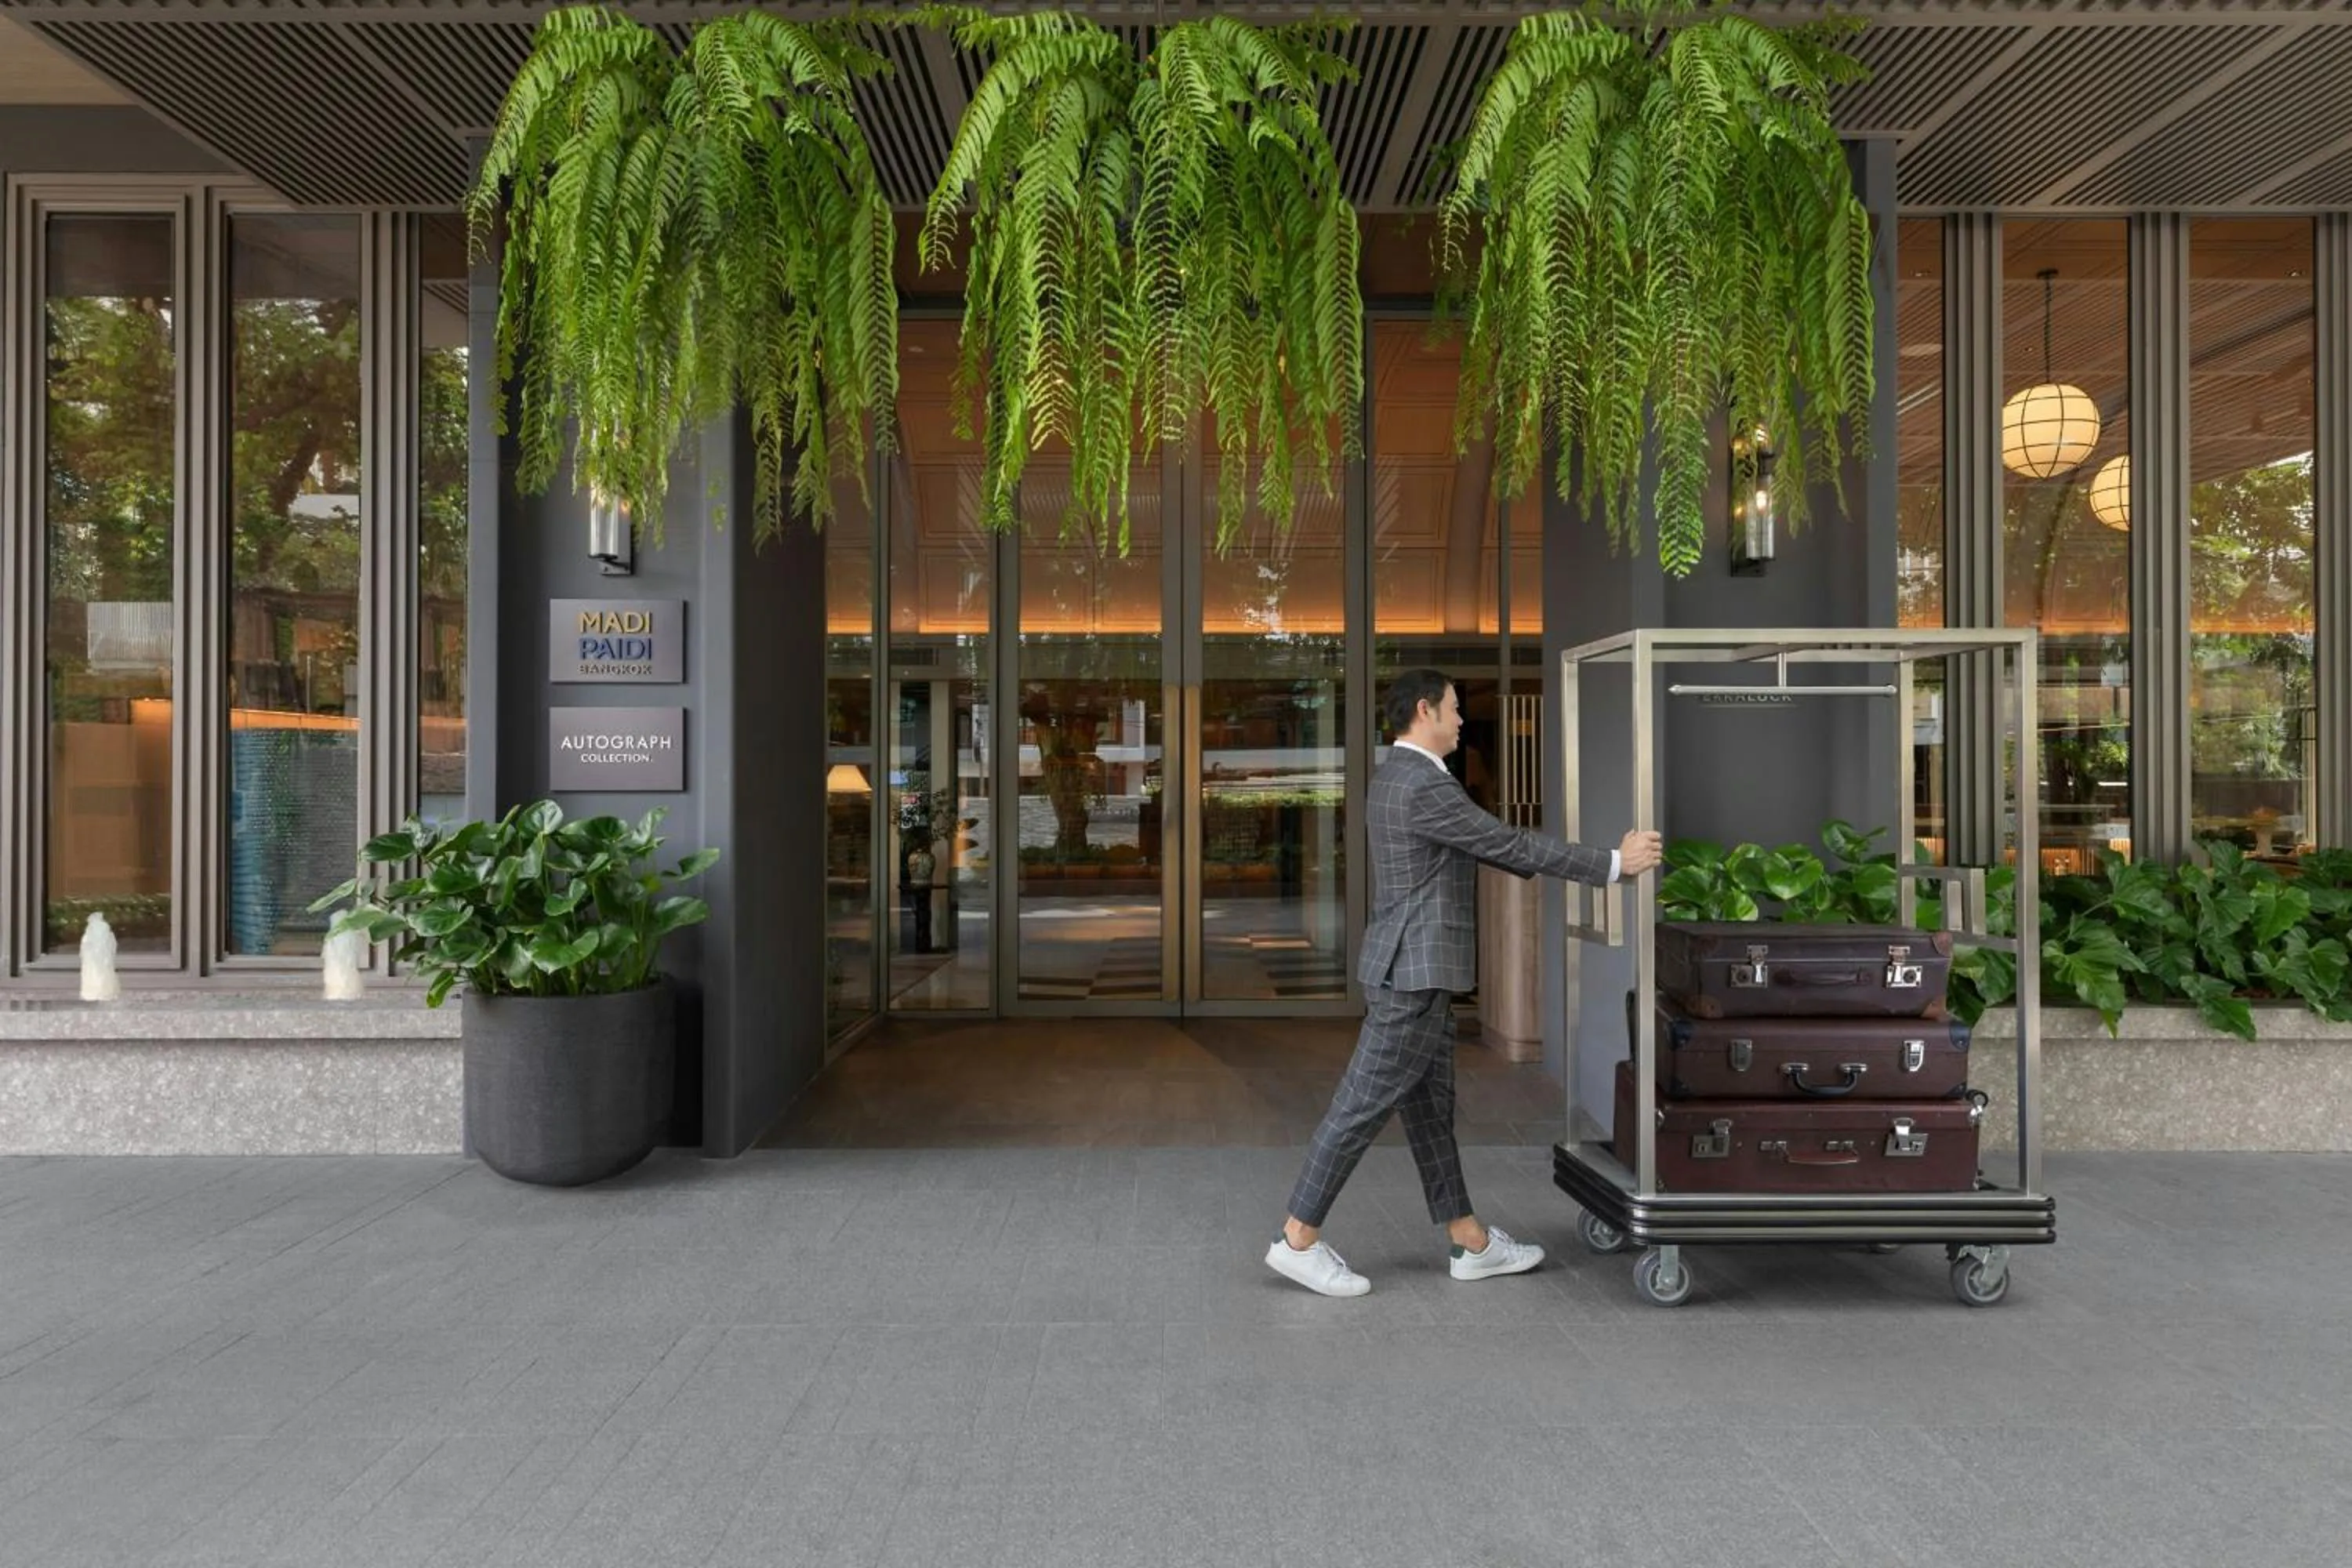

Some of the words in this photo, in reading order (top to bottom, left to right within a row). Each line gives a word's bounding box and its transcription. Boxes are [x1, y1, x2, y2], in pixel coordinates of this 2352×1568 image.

[578, 611, 652, 634] MADI
[579, 637, 652, 660] PAIDI
[578, 664, 652, 675] BANGKOK
[561, 735, 672, 750] AUTOGRAPH
